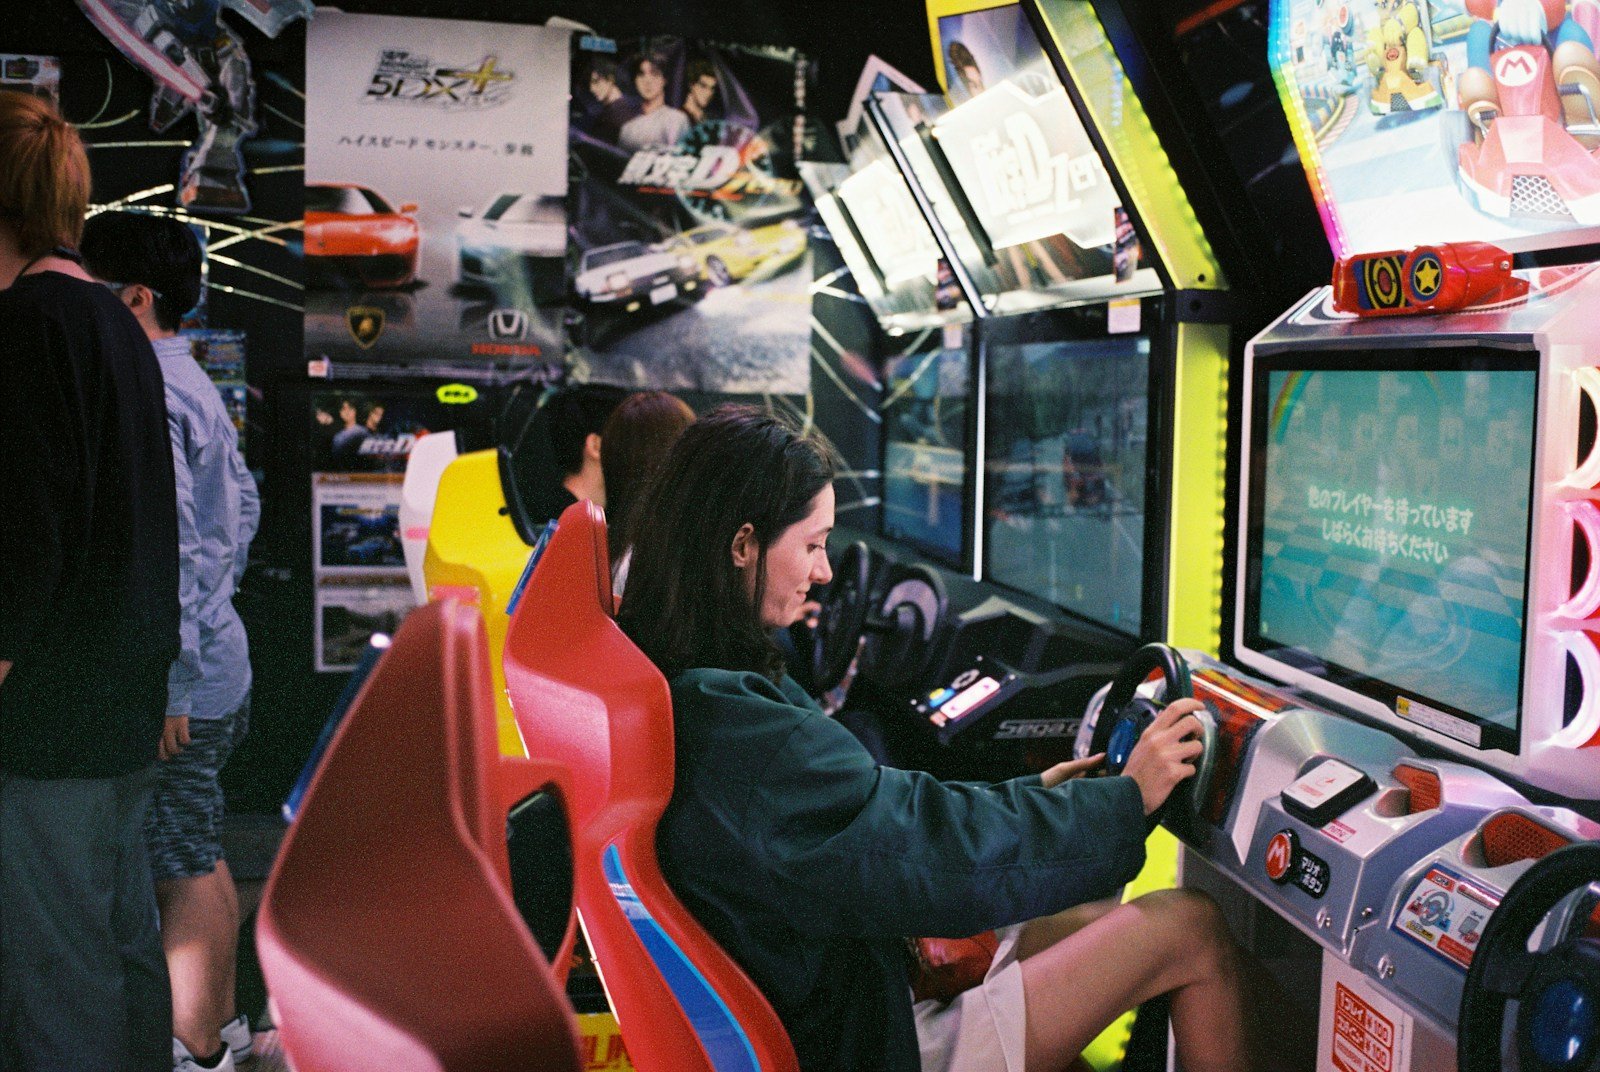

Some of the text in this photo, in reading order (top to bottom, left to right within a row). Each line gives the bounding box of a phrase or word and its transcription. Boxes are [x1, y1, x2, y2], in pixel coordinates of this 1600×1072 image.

[1322, 517, 1449, 564] しばらくお待ちください
[1301, 856, 1321, 878] マリオ
[1302, 873, 1323, 894] ボタン
